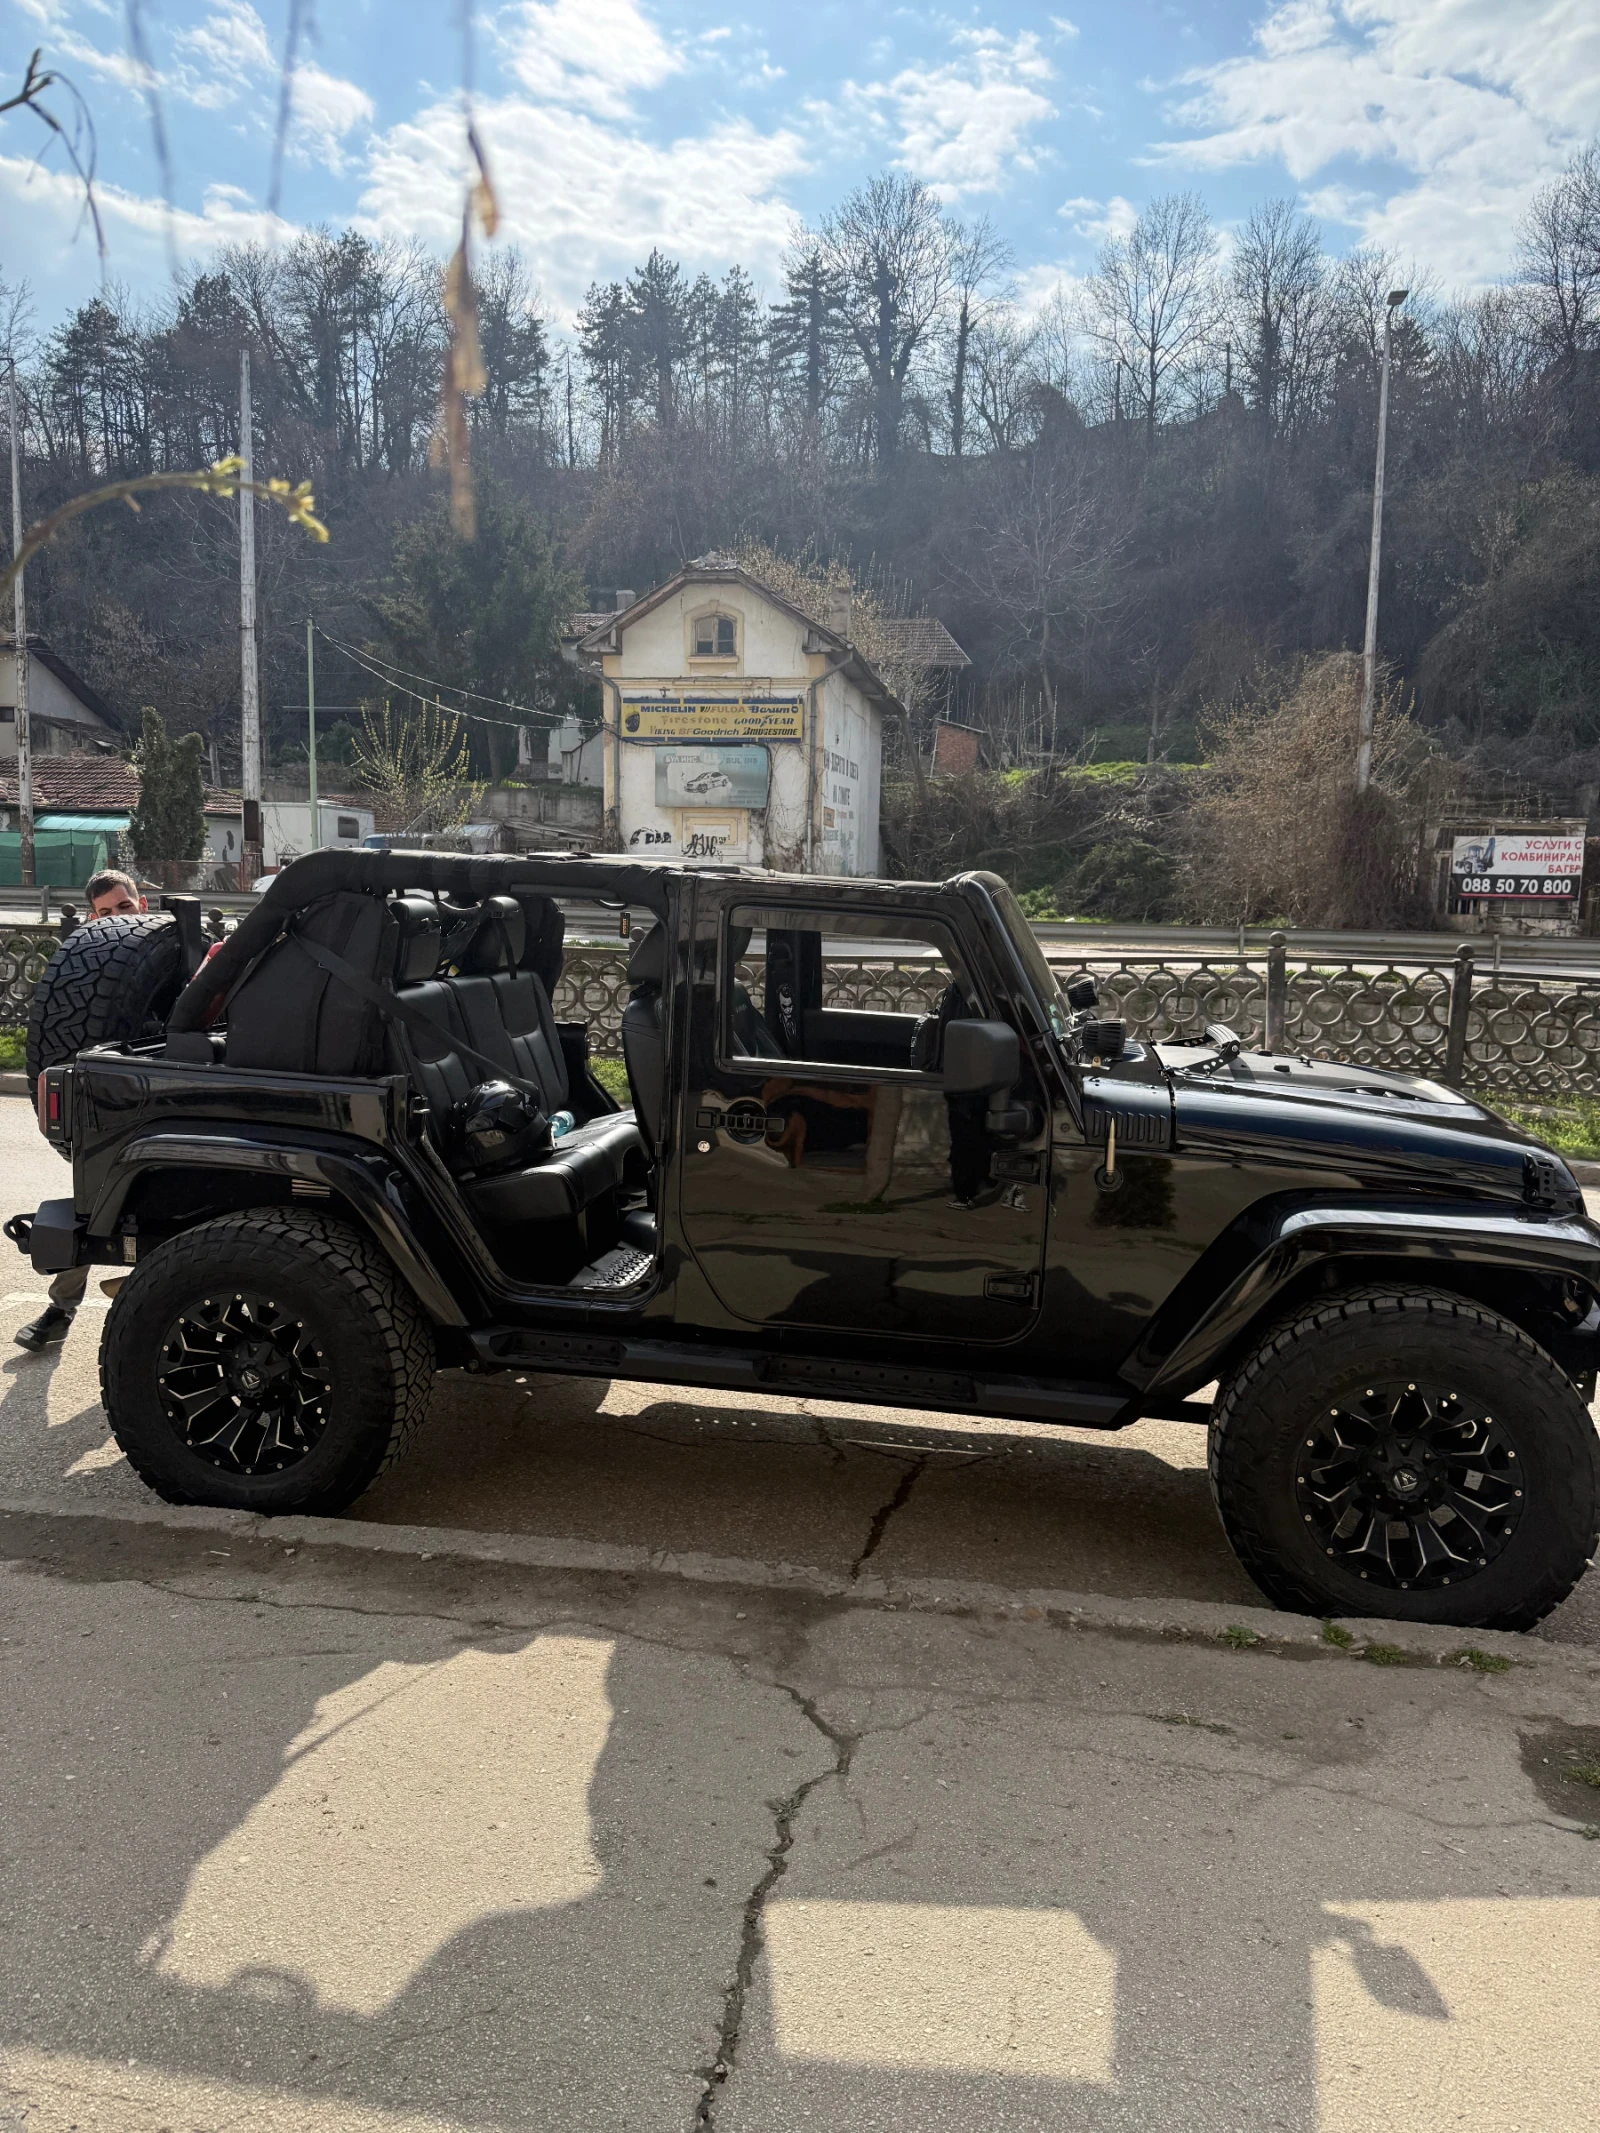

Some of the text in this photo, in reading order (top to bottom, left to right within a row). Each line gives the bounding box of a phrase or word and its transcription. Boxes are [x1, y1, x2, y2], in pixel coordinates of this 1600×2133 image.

[640, 704, 790, 714] MICHELIN FULDA Barum
[661, 715, 795, 726] Firestone GOODYEAR
[742, 727, 798, 736] BRIDGESTONE
[1525, 840, 1582, 850] УСЛУГИ С
[1501, 851, 1581, 862] КОМБИНИРАН
[1548, 864, 1581, 874] БАГЕР
[1462, 878, 1572, 894] 088 50 70 800
